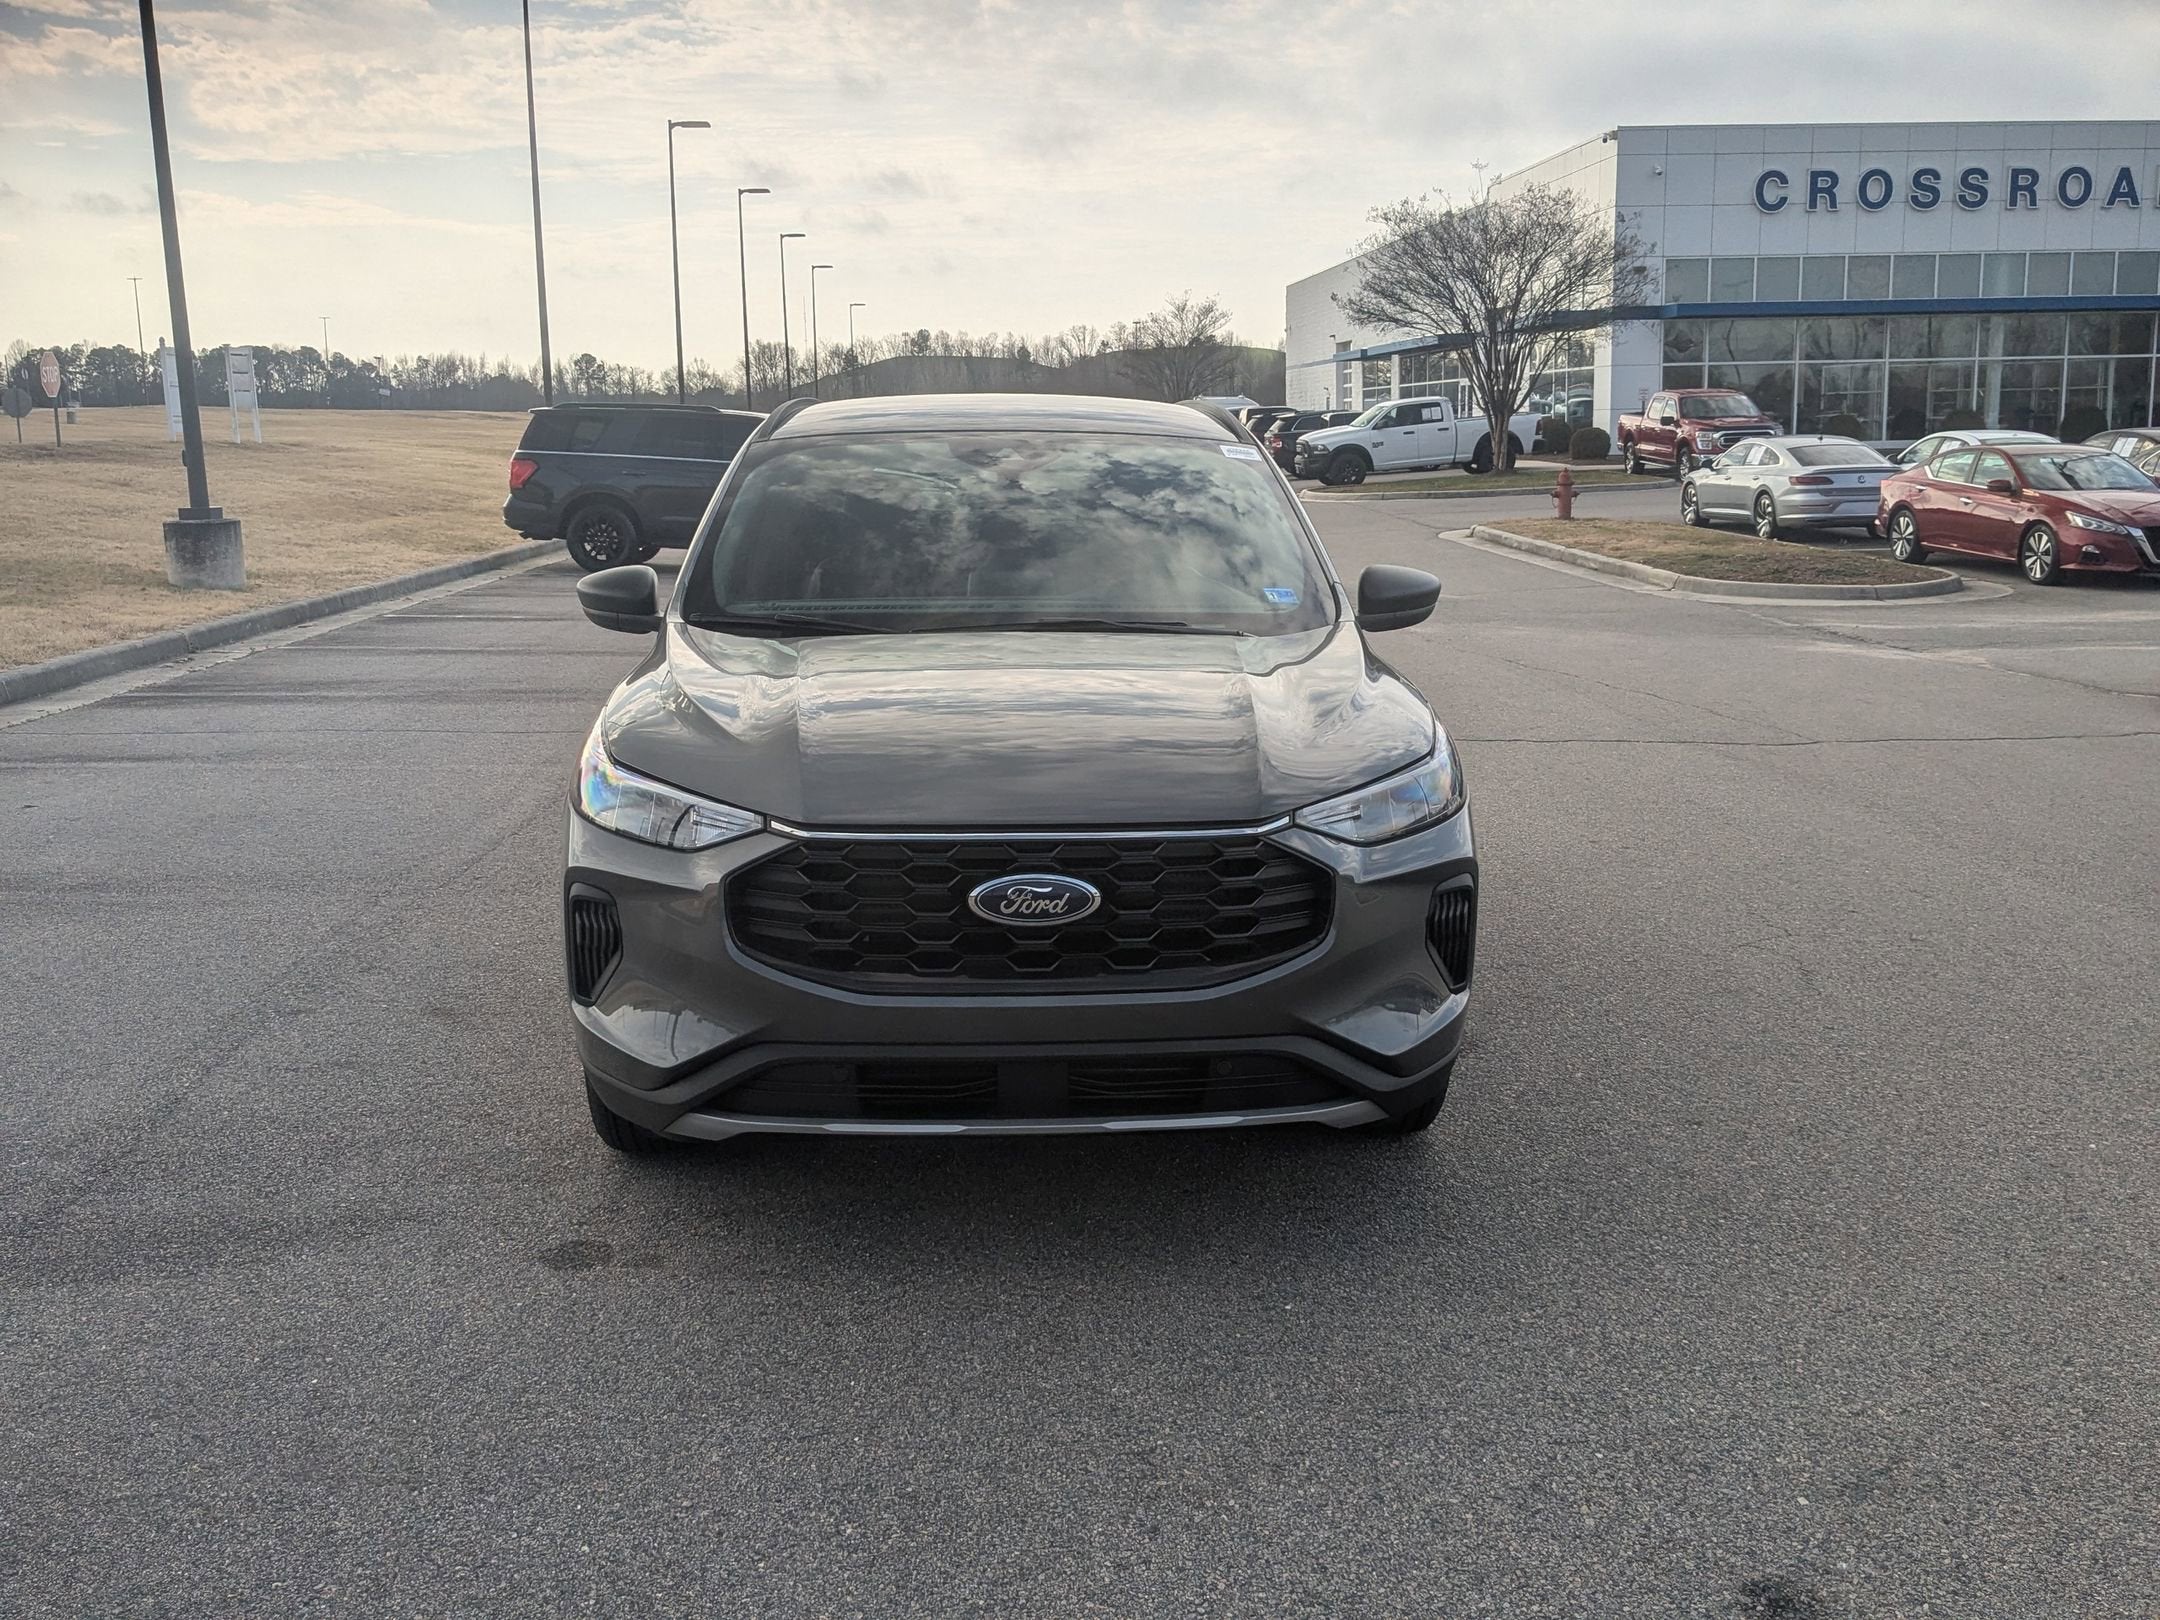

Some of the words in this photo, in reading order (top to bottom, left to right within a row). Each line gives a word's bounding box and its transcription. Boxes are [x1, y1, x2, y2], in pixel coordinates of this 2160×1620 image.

[1754, 166, 2160, 213] CROSSROA
[42, 366, 59, 382] STOP
[1000, 885, 1070, 914] Ford
